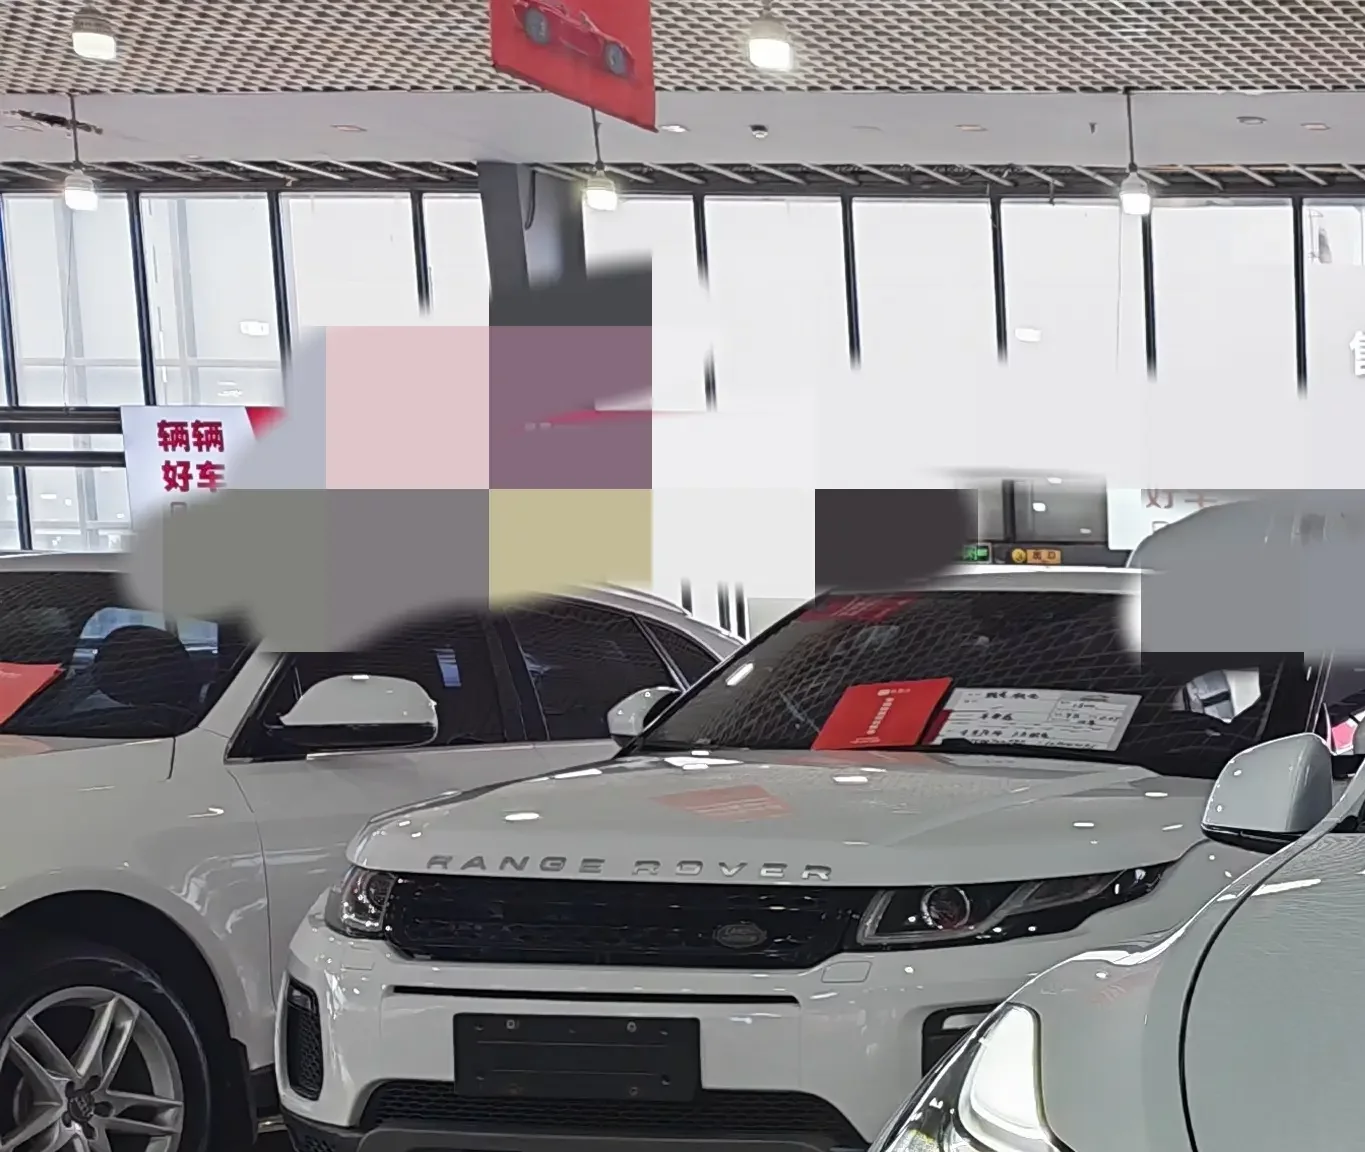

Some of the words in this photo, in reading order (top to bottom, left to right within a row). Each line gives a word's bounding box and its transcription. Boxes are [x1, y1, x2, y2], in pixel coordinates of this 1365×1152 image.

[157, 420, 225, 452] 辆辆
[161, 460, 227, 492] 好车
[426, 855, 606, 876] RANGE
[631, 859, 834, 882] ROVER
